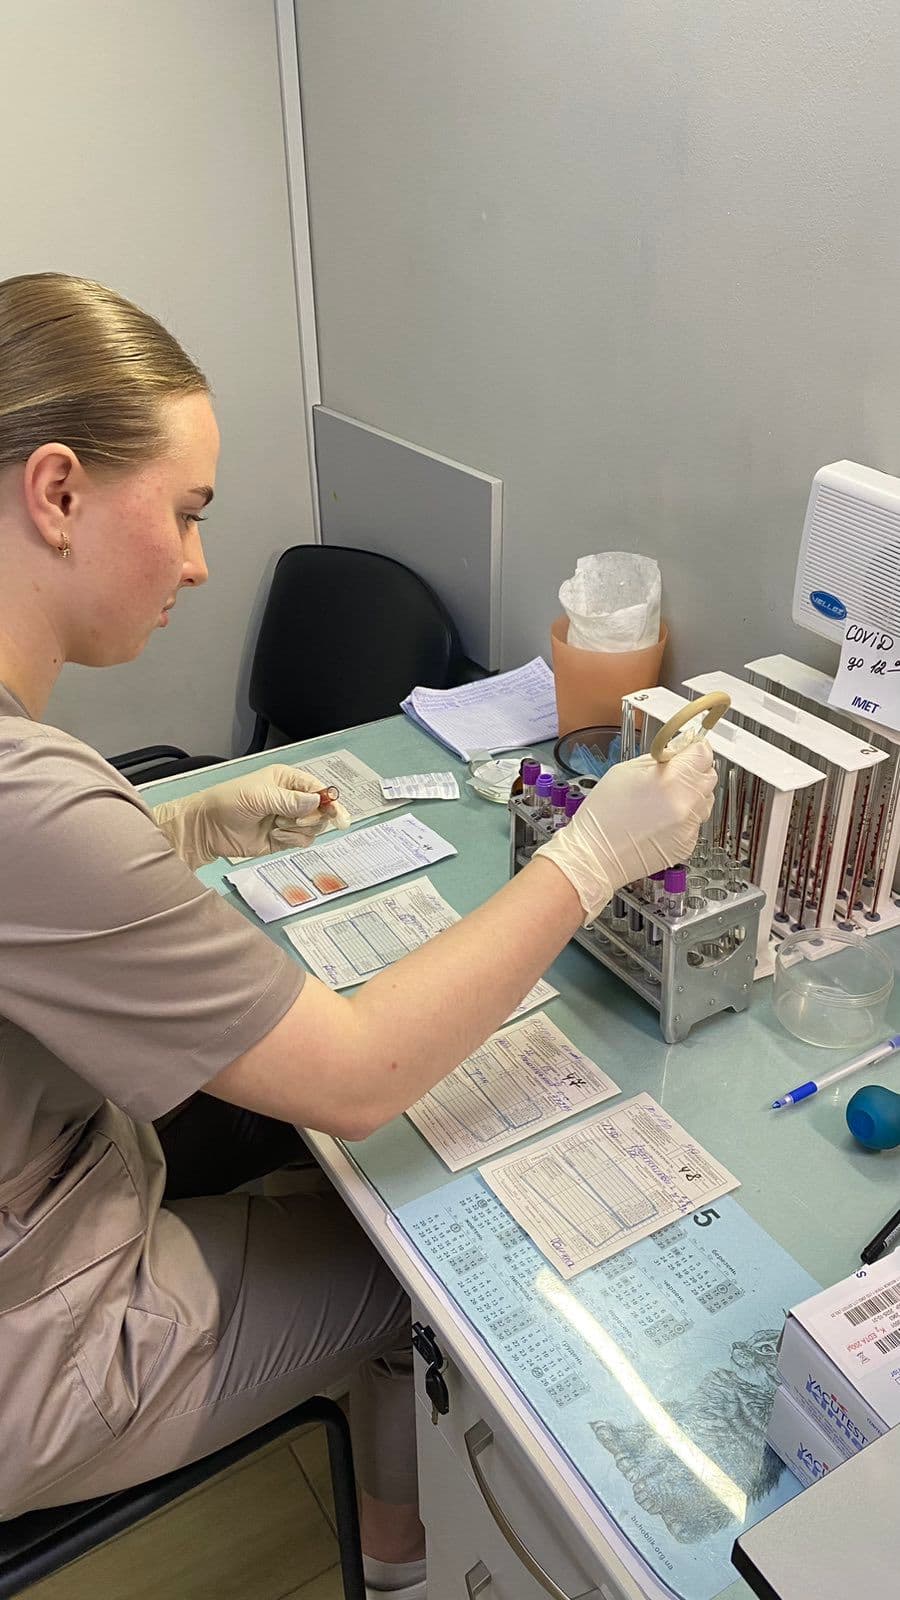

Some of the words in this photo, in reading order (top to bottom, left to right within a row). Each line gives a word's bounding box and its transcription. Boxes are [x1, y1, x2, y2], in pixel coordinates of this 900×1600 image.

[851, 696, 880, 714] IMET
[677, 1165, 701, 1182] 48
[693, 1208, 721, 1227] 5
[808, 1374, 869, 1444] VACUTEST
